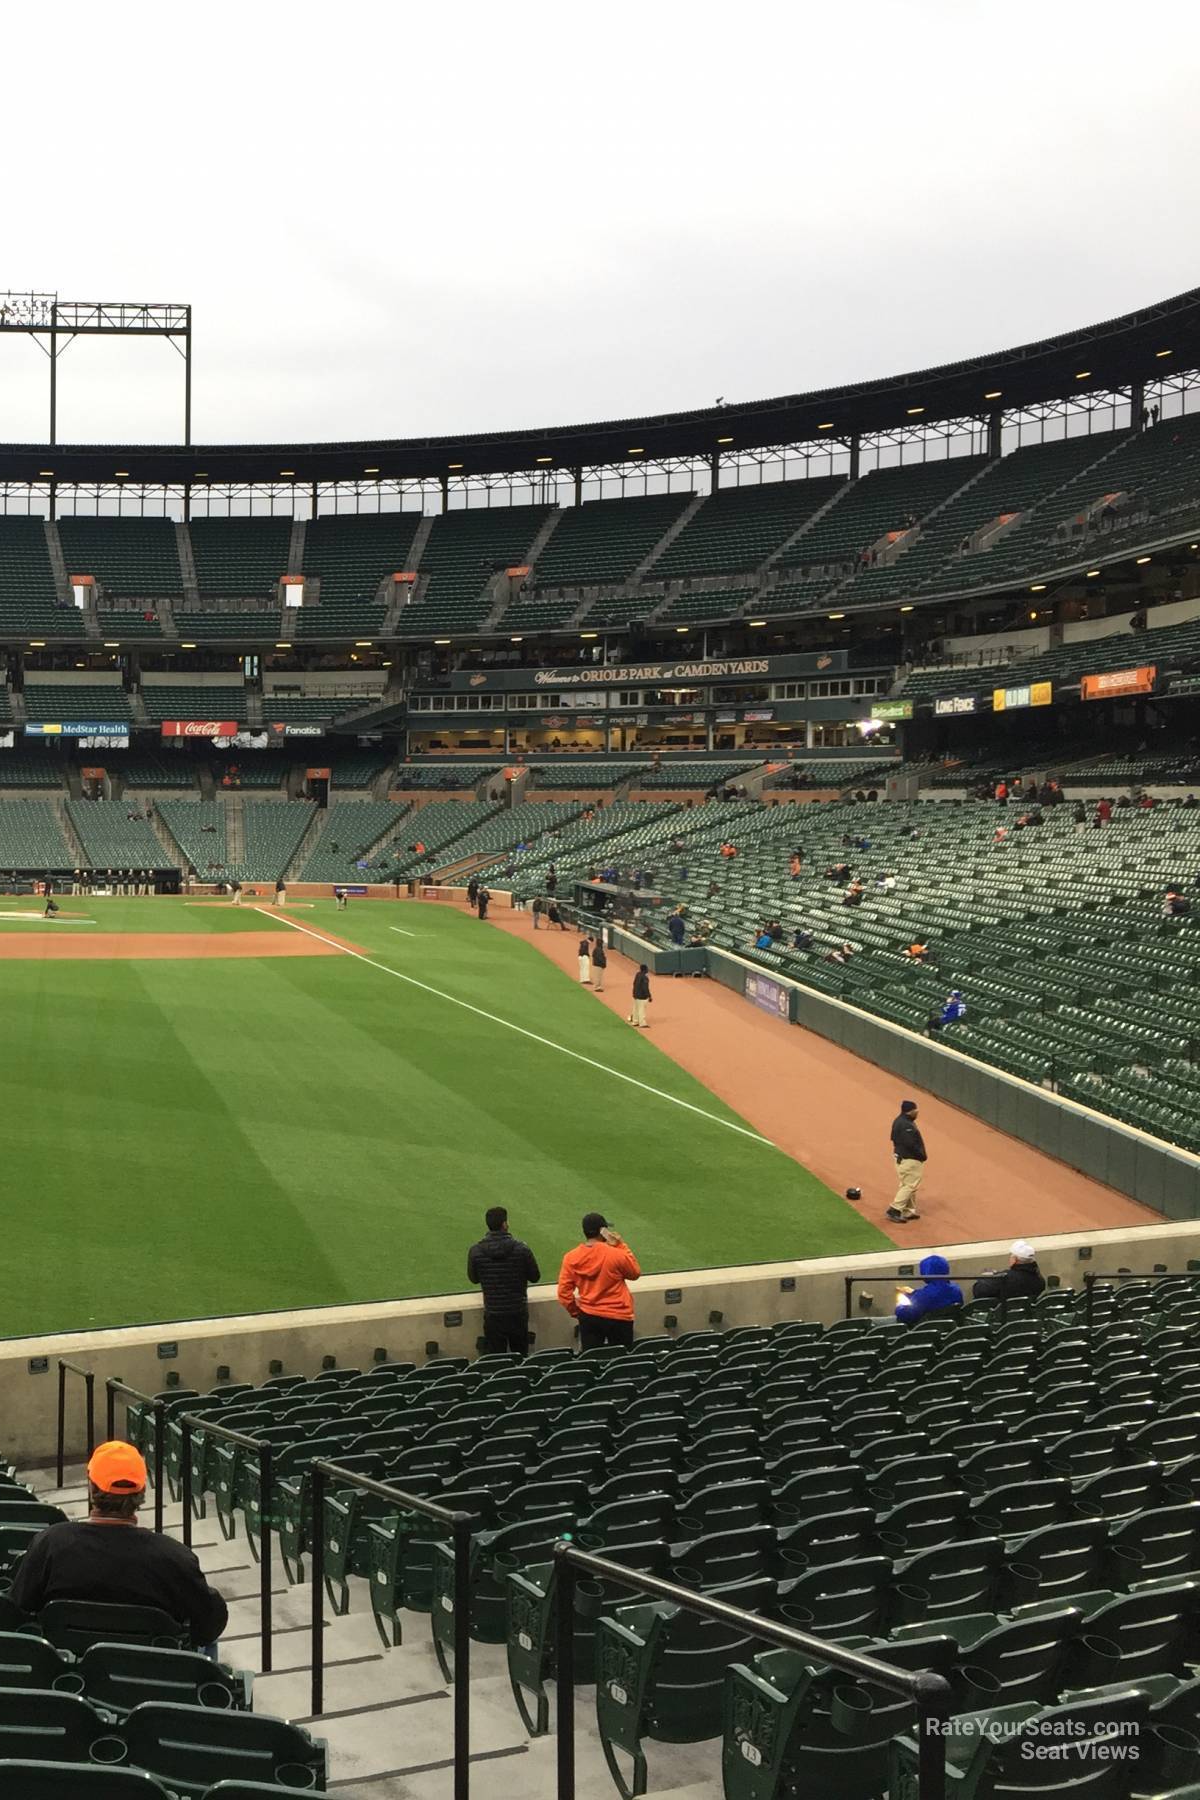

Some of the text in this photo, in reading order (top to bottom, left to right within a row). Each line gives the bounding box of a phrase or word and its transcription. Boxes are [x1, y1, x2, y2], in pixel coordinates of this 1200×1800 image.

[534, 669, 572, 685] Welcome
[580, 669, 629, 682] ORIOLE
[629, 666, 662, 680] PARK
[674, 663, 730, 677] CAMDEN
[730, 660, 769, 674] YARDS
[935, 697, 976, 714] LONG FENCE
[62, 724, 128, 734] MedStar Health
[285, 725, 322, 735] Fanatics
[613, 1686, 625, 1702] 12
[745, 1745, 757, 1761] 13
